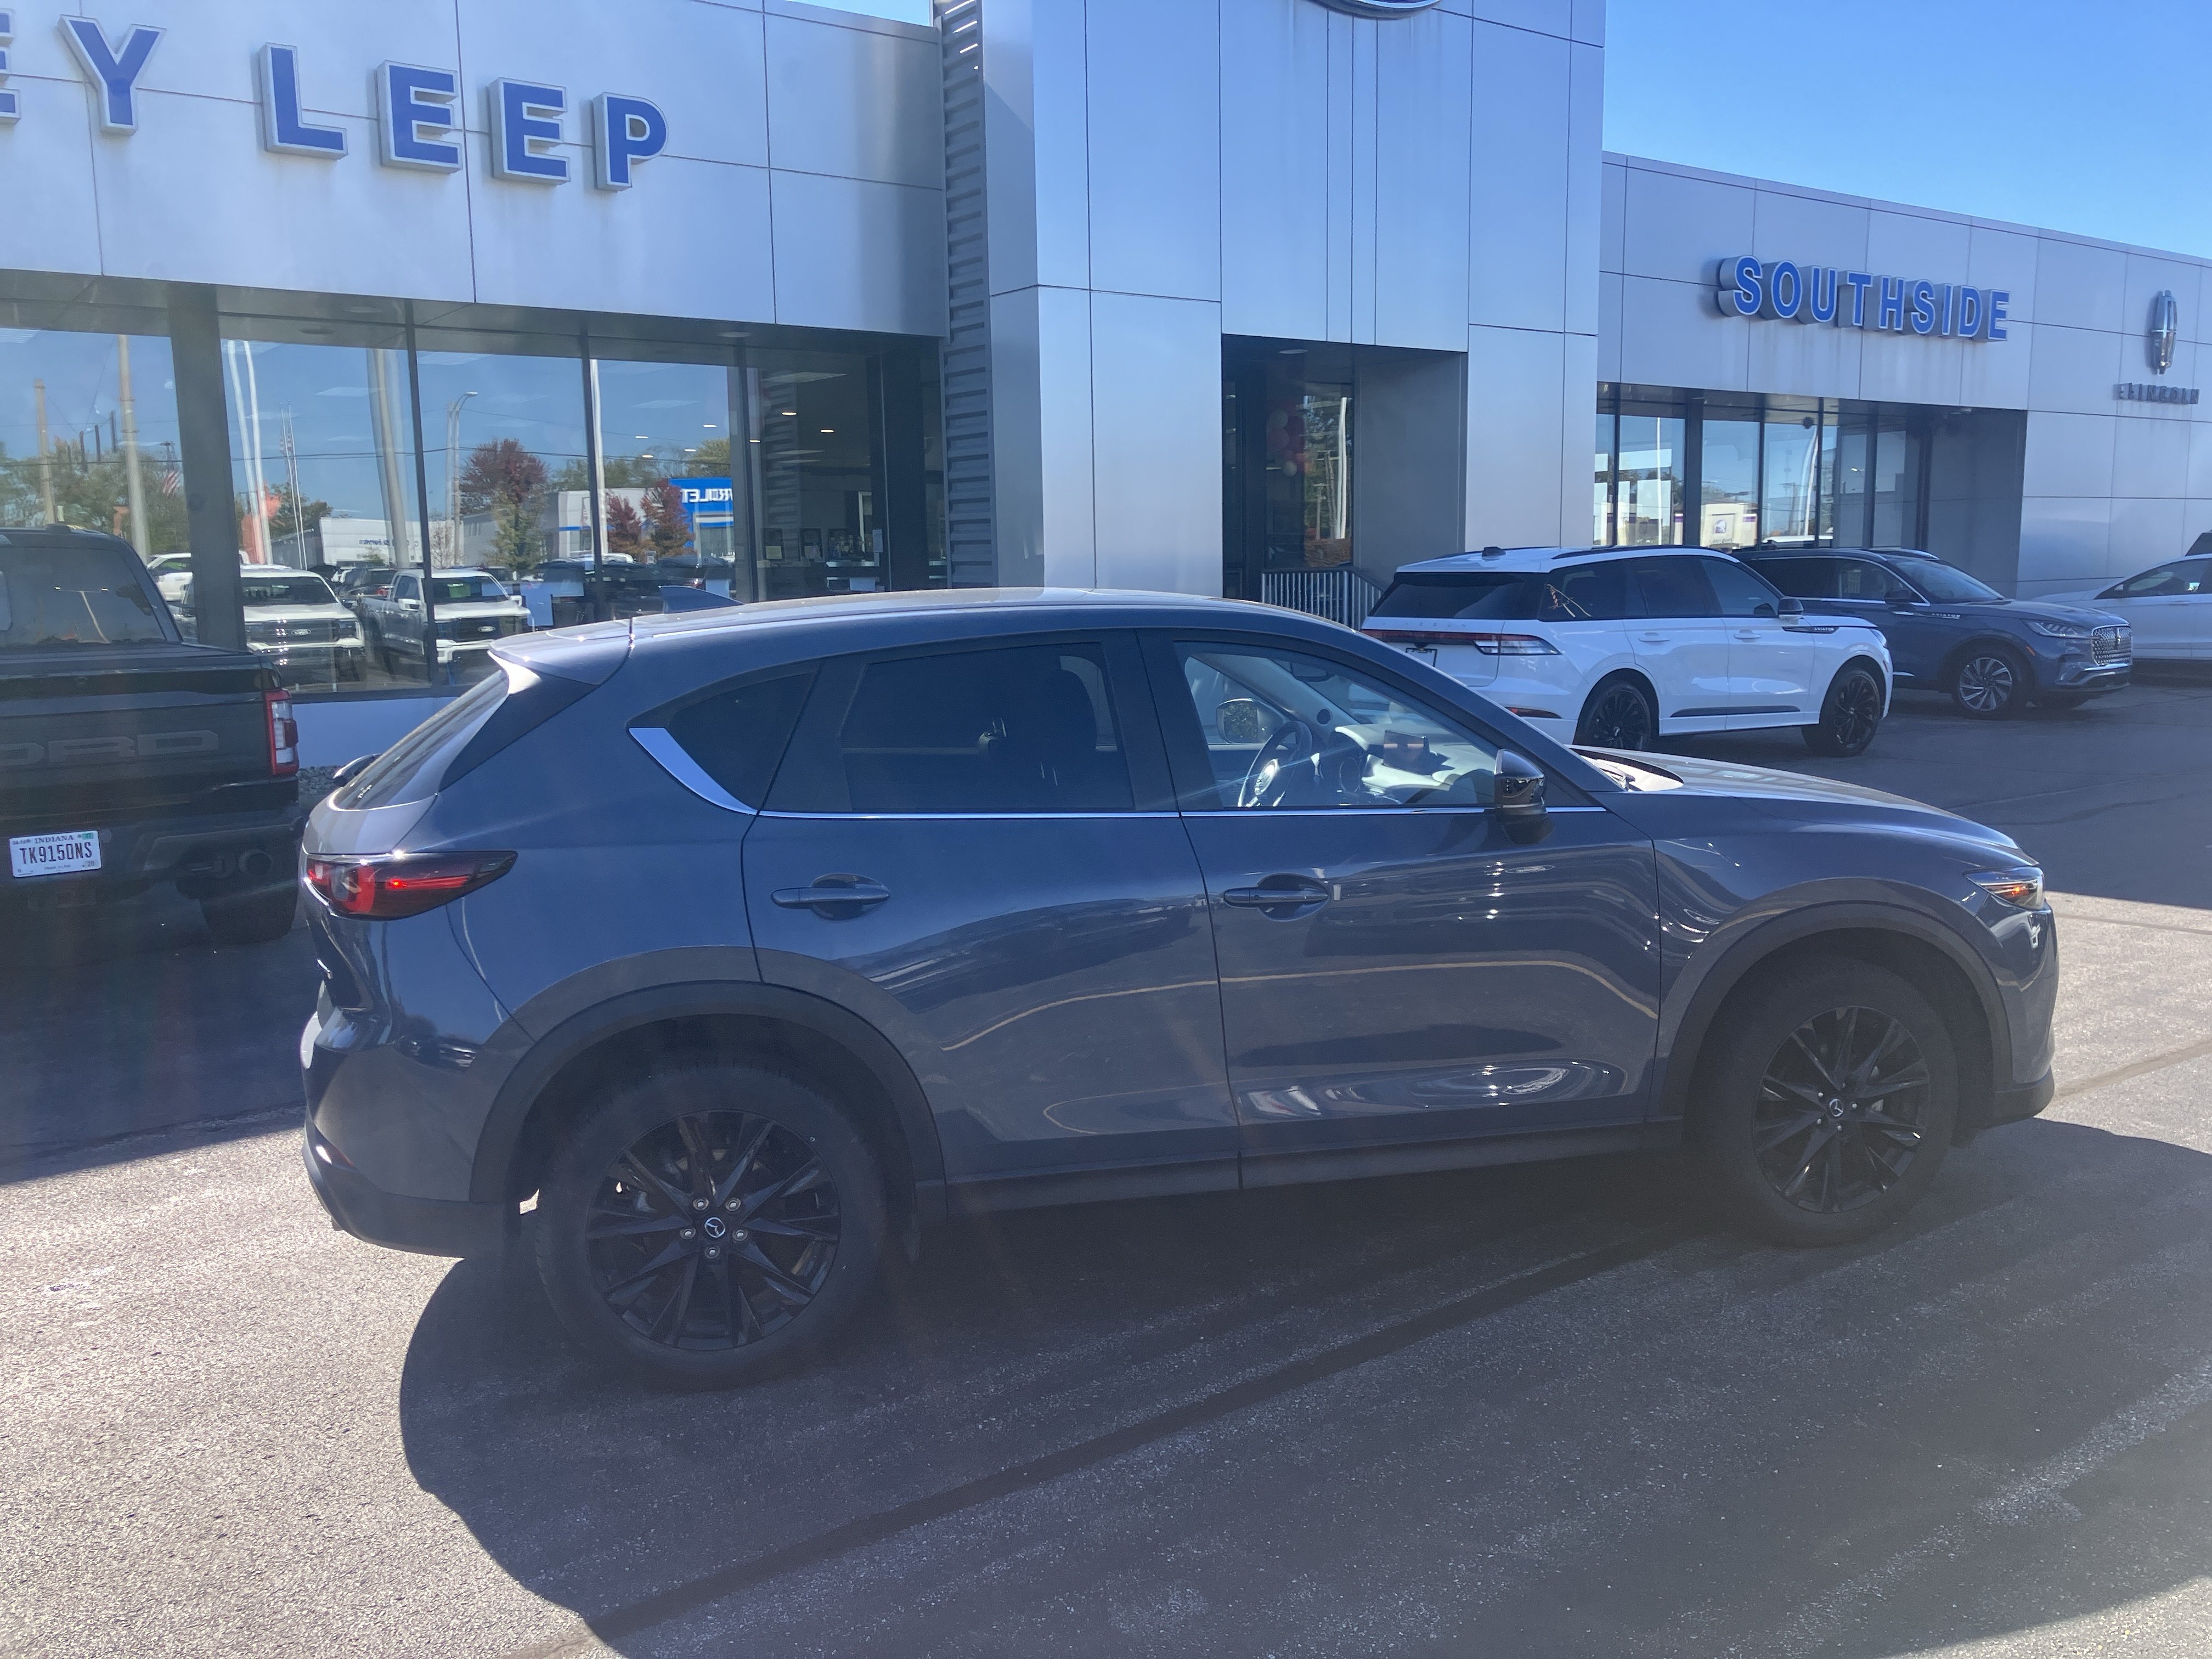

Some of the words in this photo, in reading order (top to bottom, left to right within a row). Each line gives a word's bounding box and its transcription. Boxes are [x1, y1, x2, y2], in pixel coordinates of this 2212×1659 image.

[259, 42, 668, 191] LEEP
[1722, 255, 2010, 342] SOUTHSIDE
[35, 834, 75, 844] INDIANA
